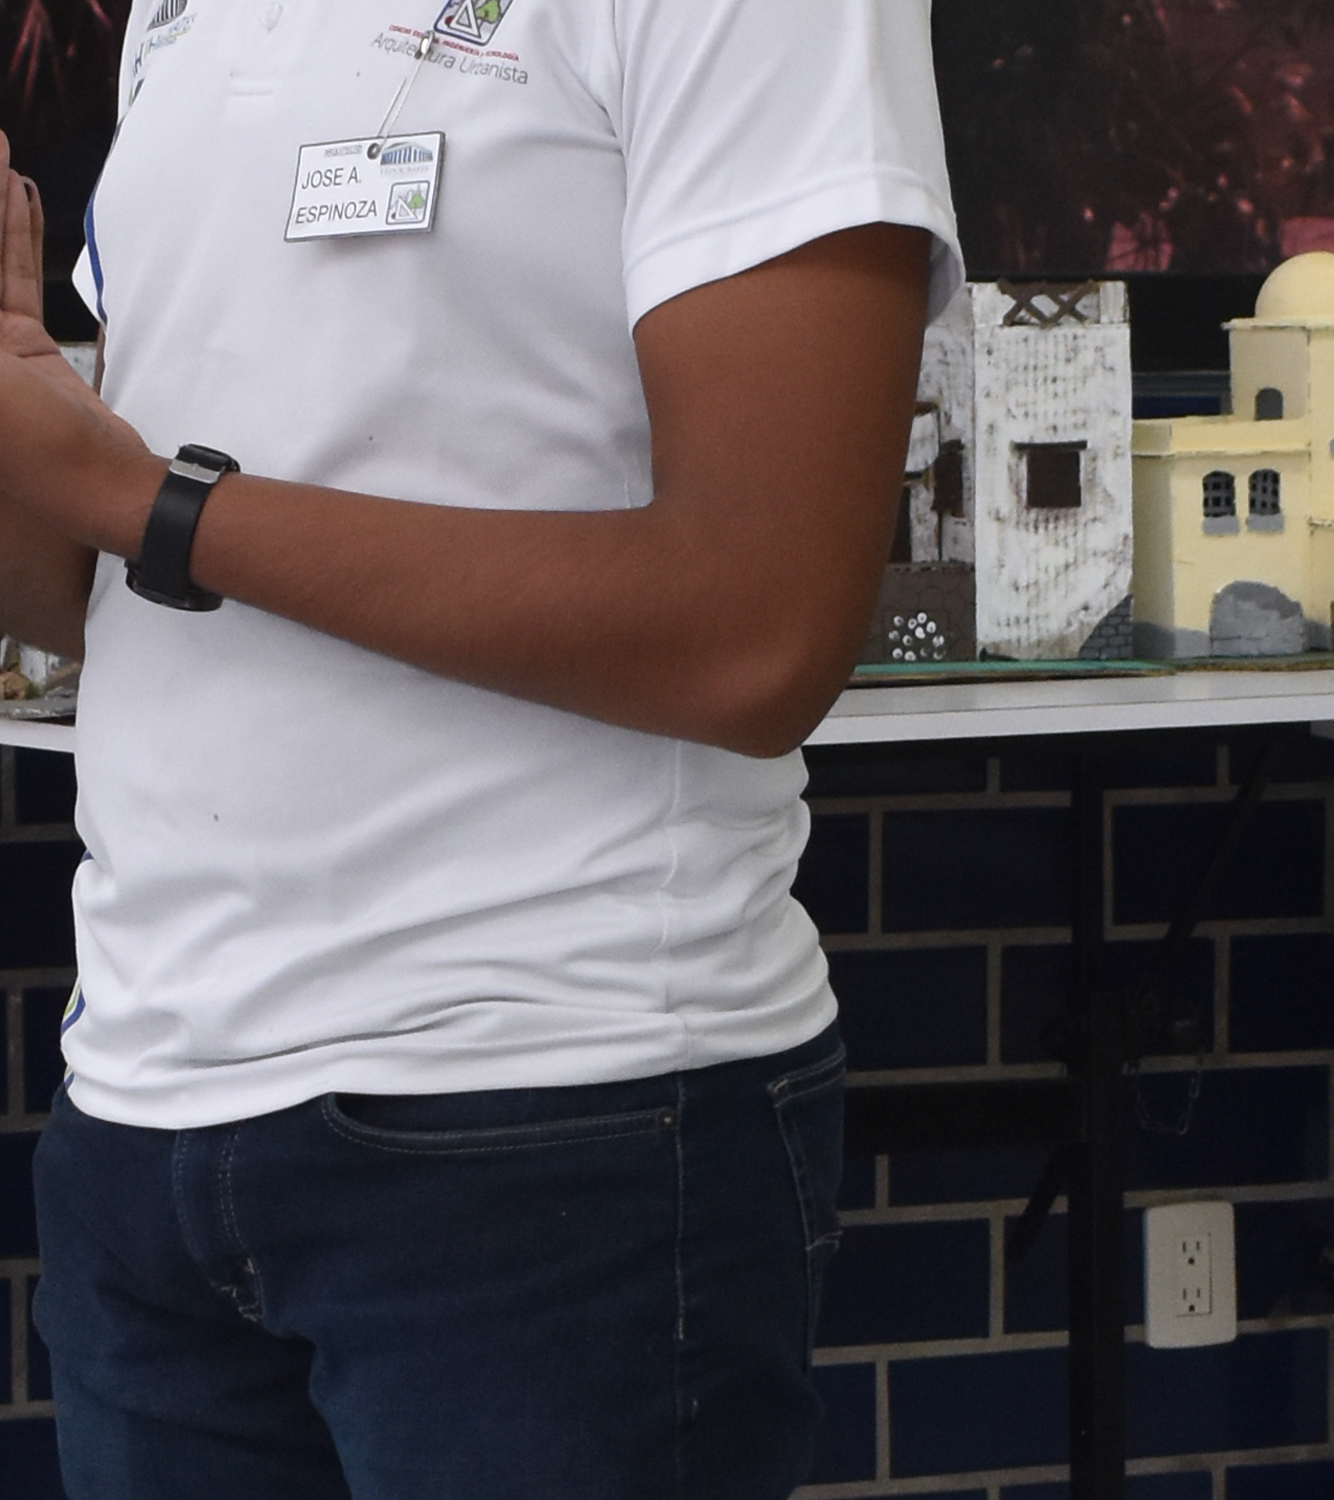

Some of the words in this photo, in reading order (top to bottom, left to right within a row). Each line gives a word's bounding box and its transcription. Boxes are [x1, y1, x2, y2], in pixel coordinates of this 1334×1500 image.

[371, 32, 456, 69] Arquitetura
[301, 167, 344, 189] JOSE
[347, 166, 362, 184] A.
[295, 199, 378, 224] ESPINOZA
